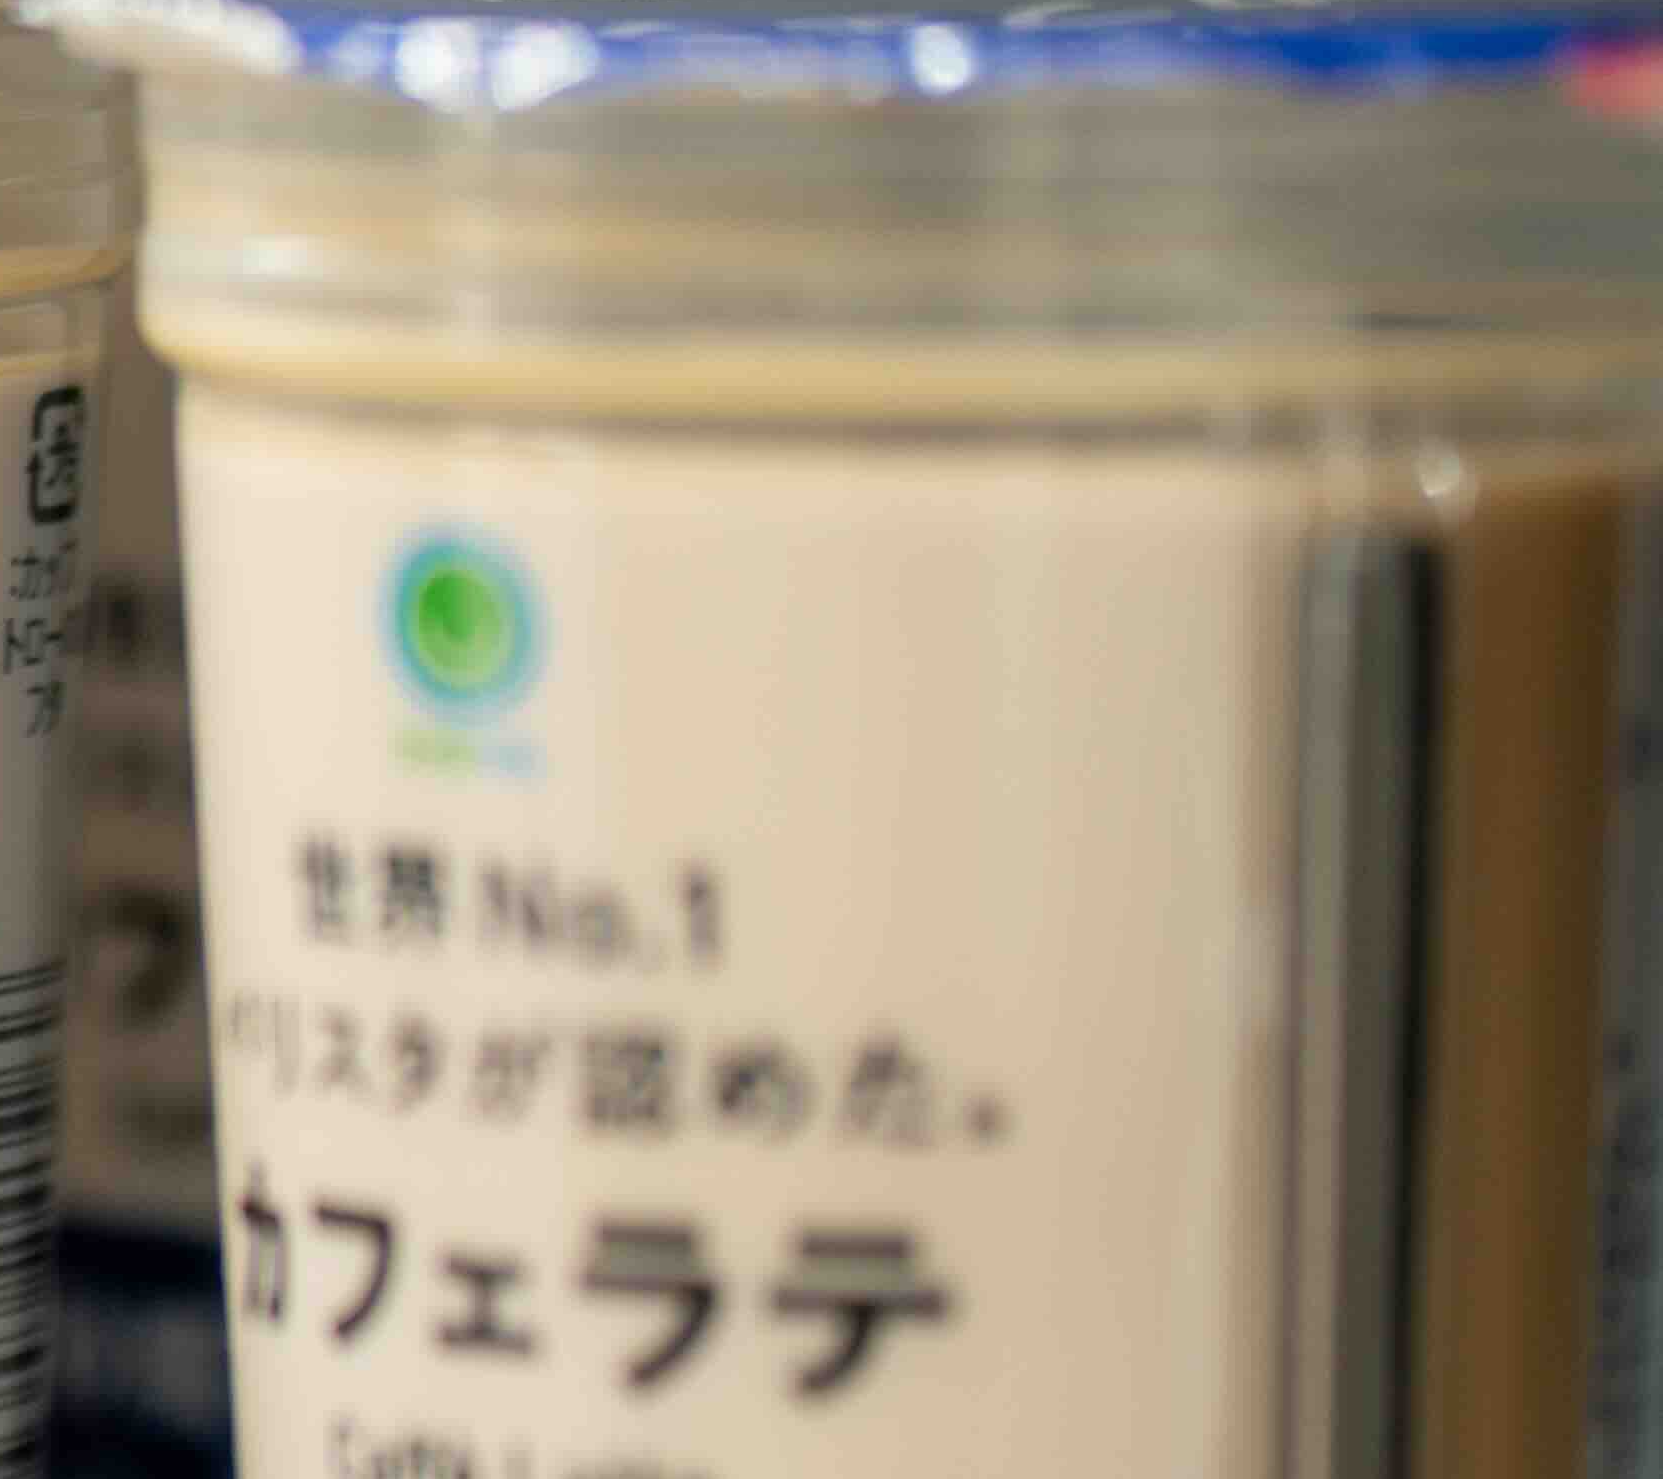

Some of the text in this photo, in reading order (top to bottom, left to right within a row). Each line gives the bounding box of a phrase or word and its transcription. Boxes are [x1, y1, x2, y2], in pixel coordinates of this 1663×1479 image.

[240, 1162, 949, 1400] カフェラテ
